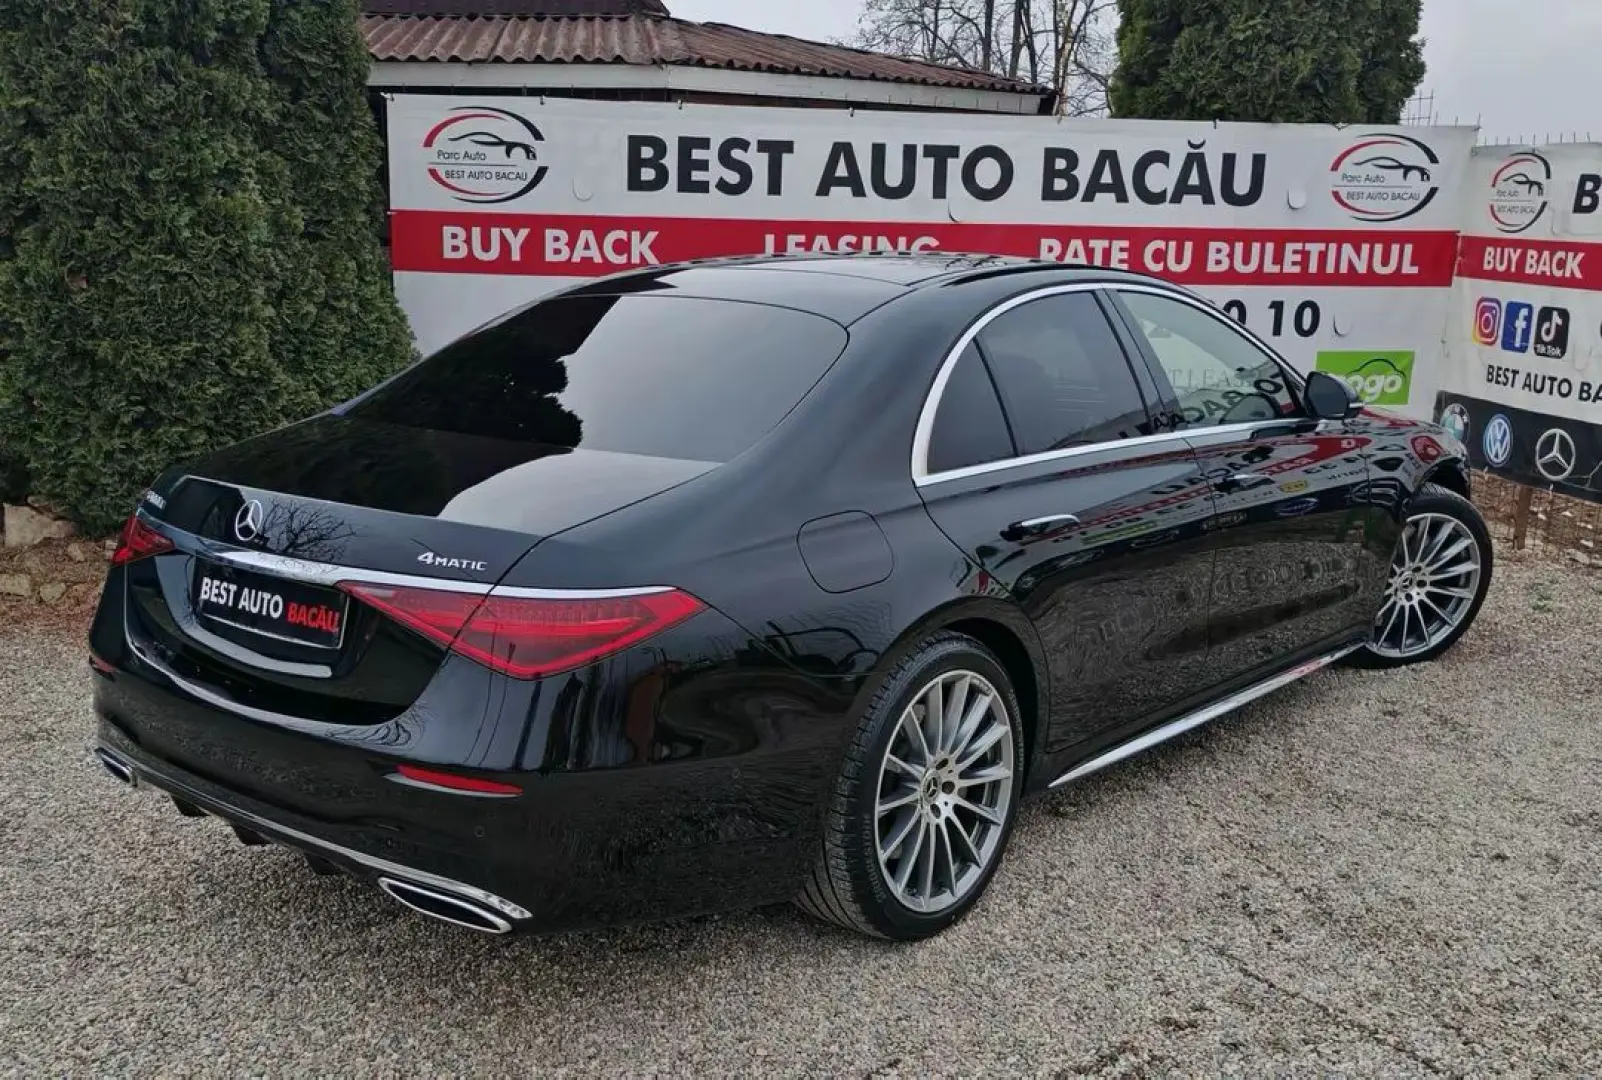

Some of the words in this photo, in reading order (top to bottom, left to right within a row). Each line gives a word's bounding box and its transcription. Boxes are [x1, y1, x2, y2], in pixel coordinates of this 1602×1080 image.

[437, 150, 460, 160] Parc
[463, 150, 487, 161] Auto
[627, 134, 794, 196] BEST
[815, 141, 1014, 201] AUTO
[1041, 139, 1267, 207] BACĂU
[445, 170, 465, 179] BEST
[468, 171, 492, 180] AUTO
[1341, 173, 1362, 183] Parc
[1364, 174, 1385, 184] Auto
[1346, 191, 1364, 200] BEST
[1366, 191, 1389, 200] AUTO
[442, 226, 530, 261] BUY
[544, 228, 660, 265] BACK
[1039, 238, 1129, 271] RATE
[1143, 240, 1194, 273] CU
[1206, 241, 1419, 275] BULETINUL
[1482, 245, 1522, 273] BUY
[1524, 248, 1585, 280] BACK
[1267, 299, 1321, 338] 10
[1486, 364, 1520, 388] BEST
[1521, 371, 1573, 399] AUTO
[417, 551, 487, 571] 4MATIC
[200, 576, 238, 607] BEST
[238, 586, 283, 619] AUTO
[286, 601, 340, 633] BACĂU
